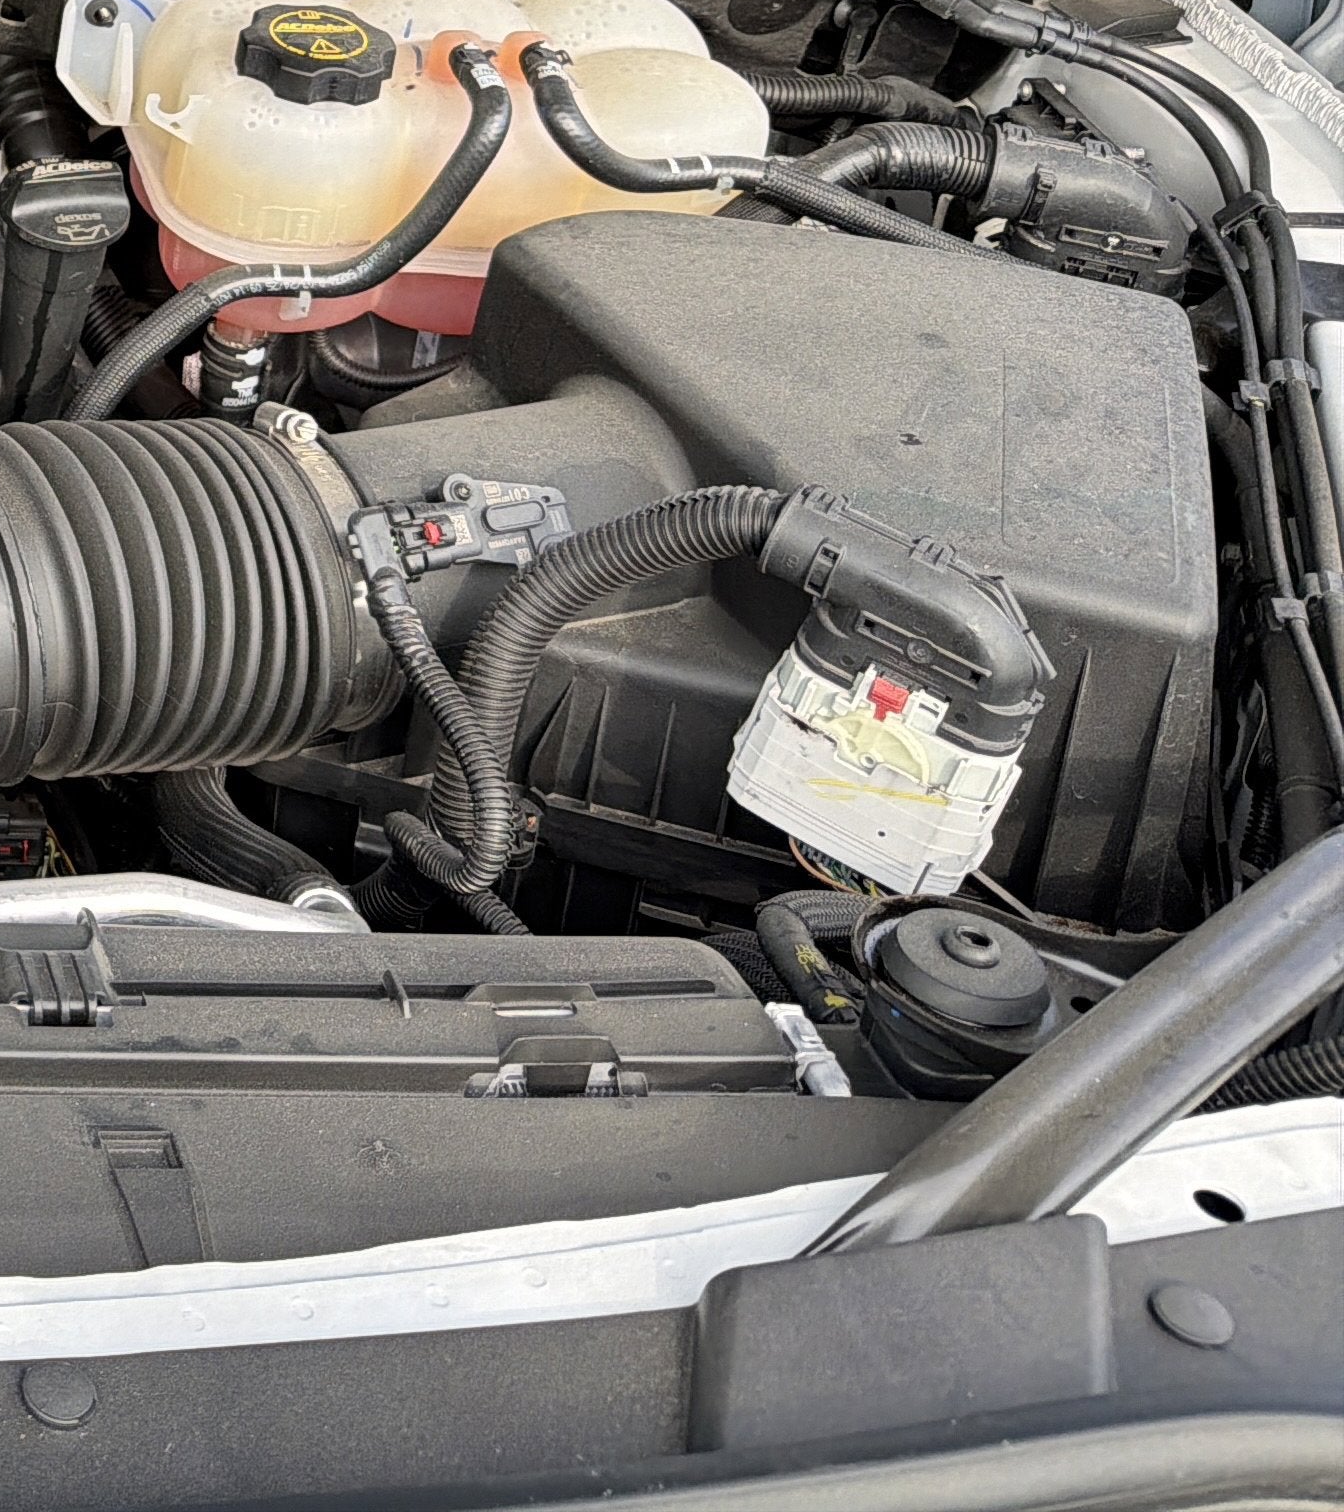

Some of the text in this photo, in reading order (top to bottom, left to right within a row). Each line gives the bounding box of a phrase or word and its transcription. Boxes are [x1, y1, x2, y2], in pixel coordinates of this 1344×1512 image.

[273, 22, 357, 33] ACDelco
[32, 160, 113, 179] ACDelco
[55, 213, 102, 224] dexos
